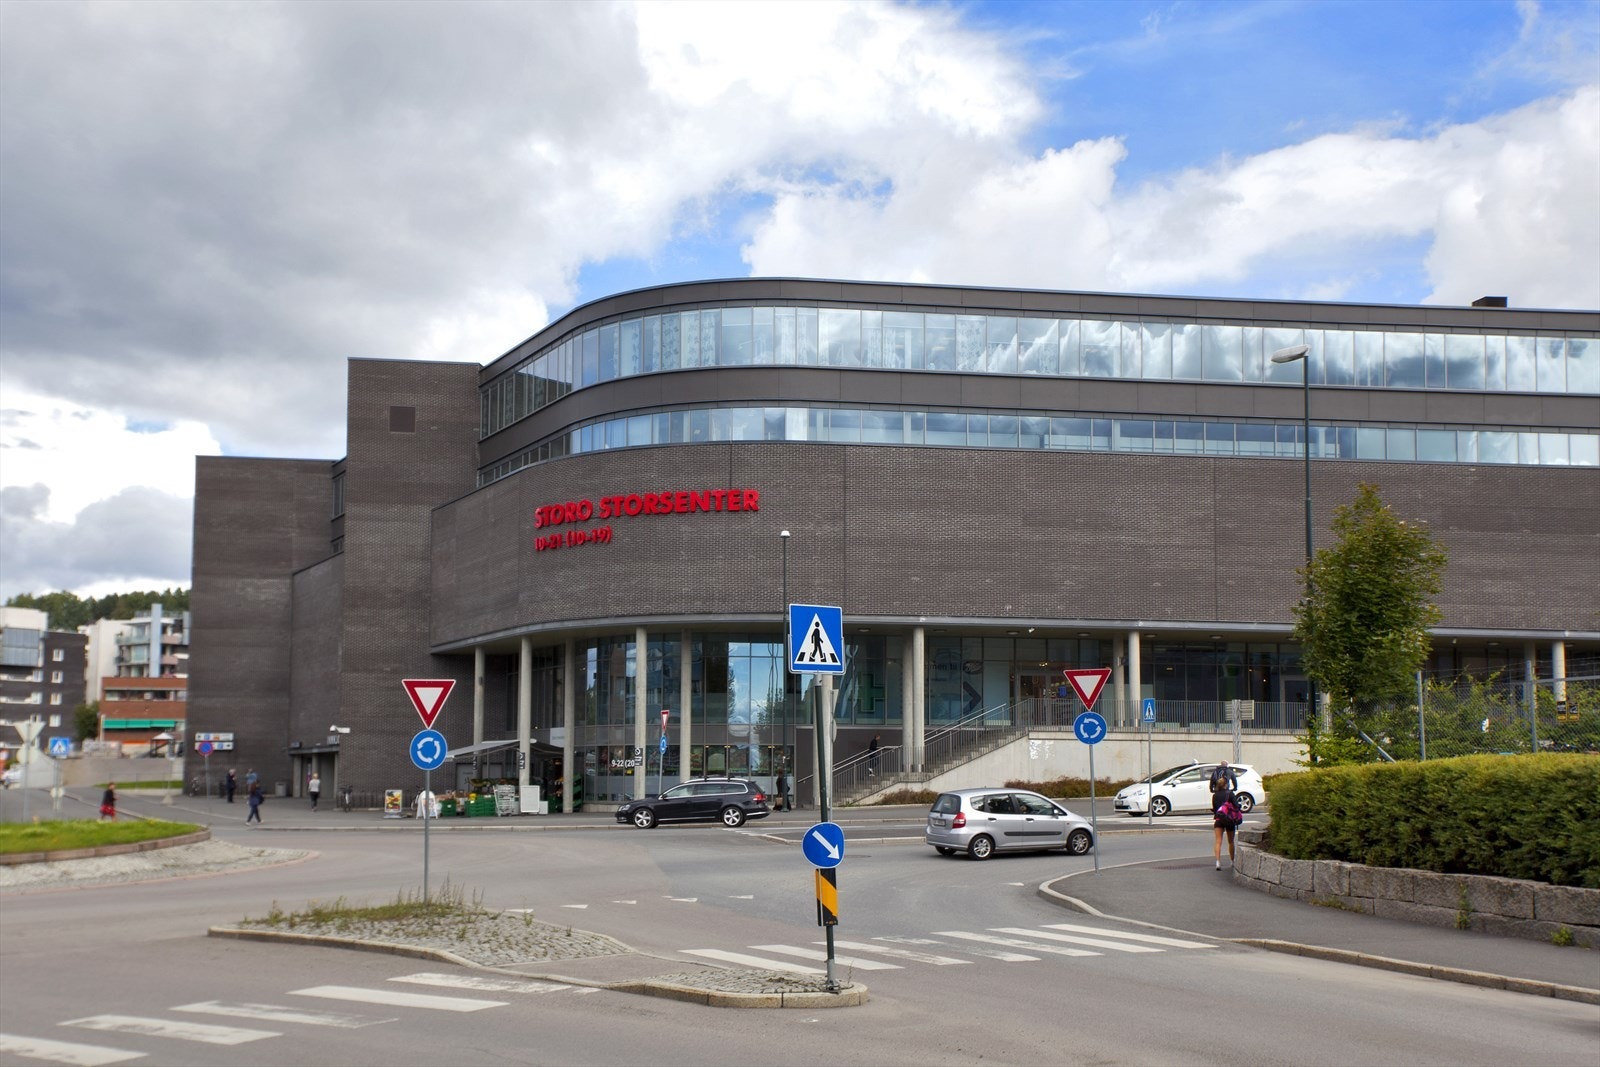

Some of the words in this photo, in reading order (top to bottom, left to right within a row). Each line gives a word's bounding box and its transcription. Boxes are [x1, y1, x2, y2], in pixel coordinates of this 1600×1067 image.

[534, 499, 594, 529] STORO
[599, 489, 760, 519] STORSENTER
[534, 533, 563, 551] 10-21
[565, 525, 613, 548] (10-19)
[611, 759, 624, 767] 9-22
[624, 759, 635, 768] (20
